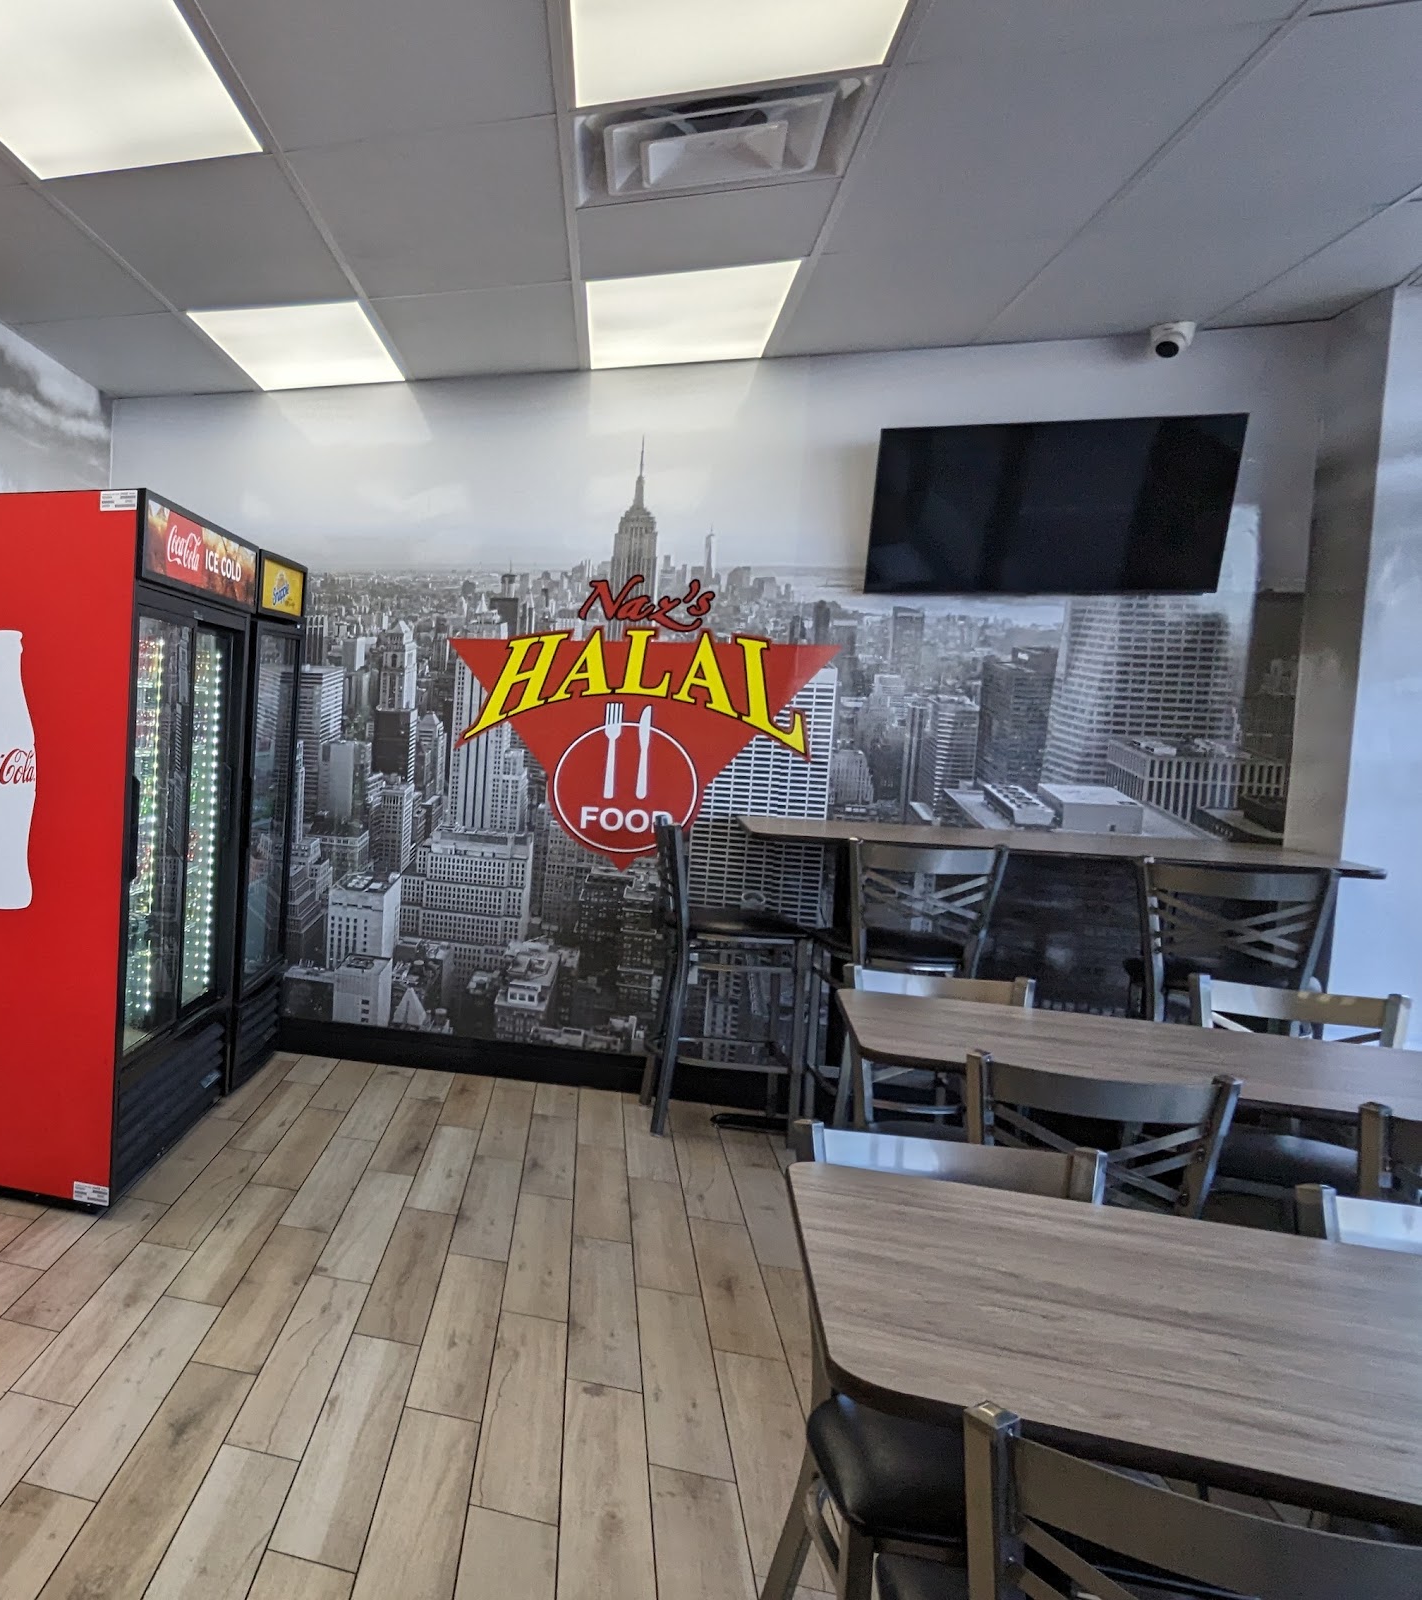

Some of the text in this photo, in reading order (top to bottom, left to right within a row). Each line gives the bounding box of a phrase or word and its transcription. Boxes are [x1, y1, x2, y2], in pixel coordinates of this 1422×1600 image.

[166, 525, 202, 572] Coca-Cola
[205, 548, 242, 582] ICE COLD
[578, 573, 716, 633] Naz's
[459, 626, 812, 760] HALAL
